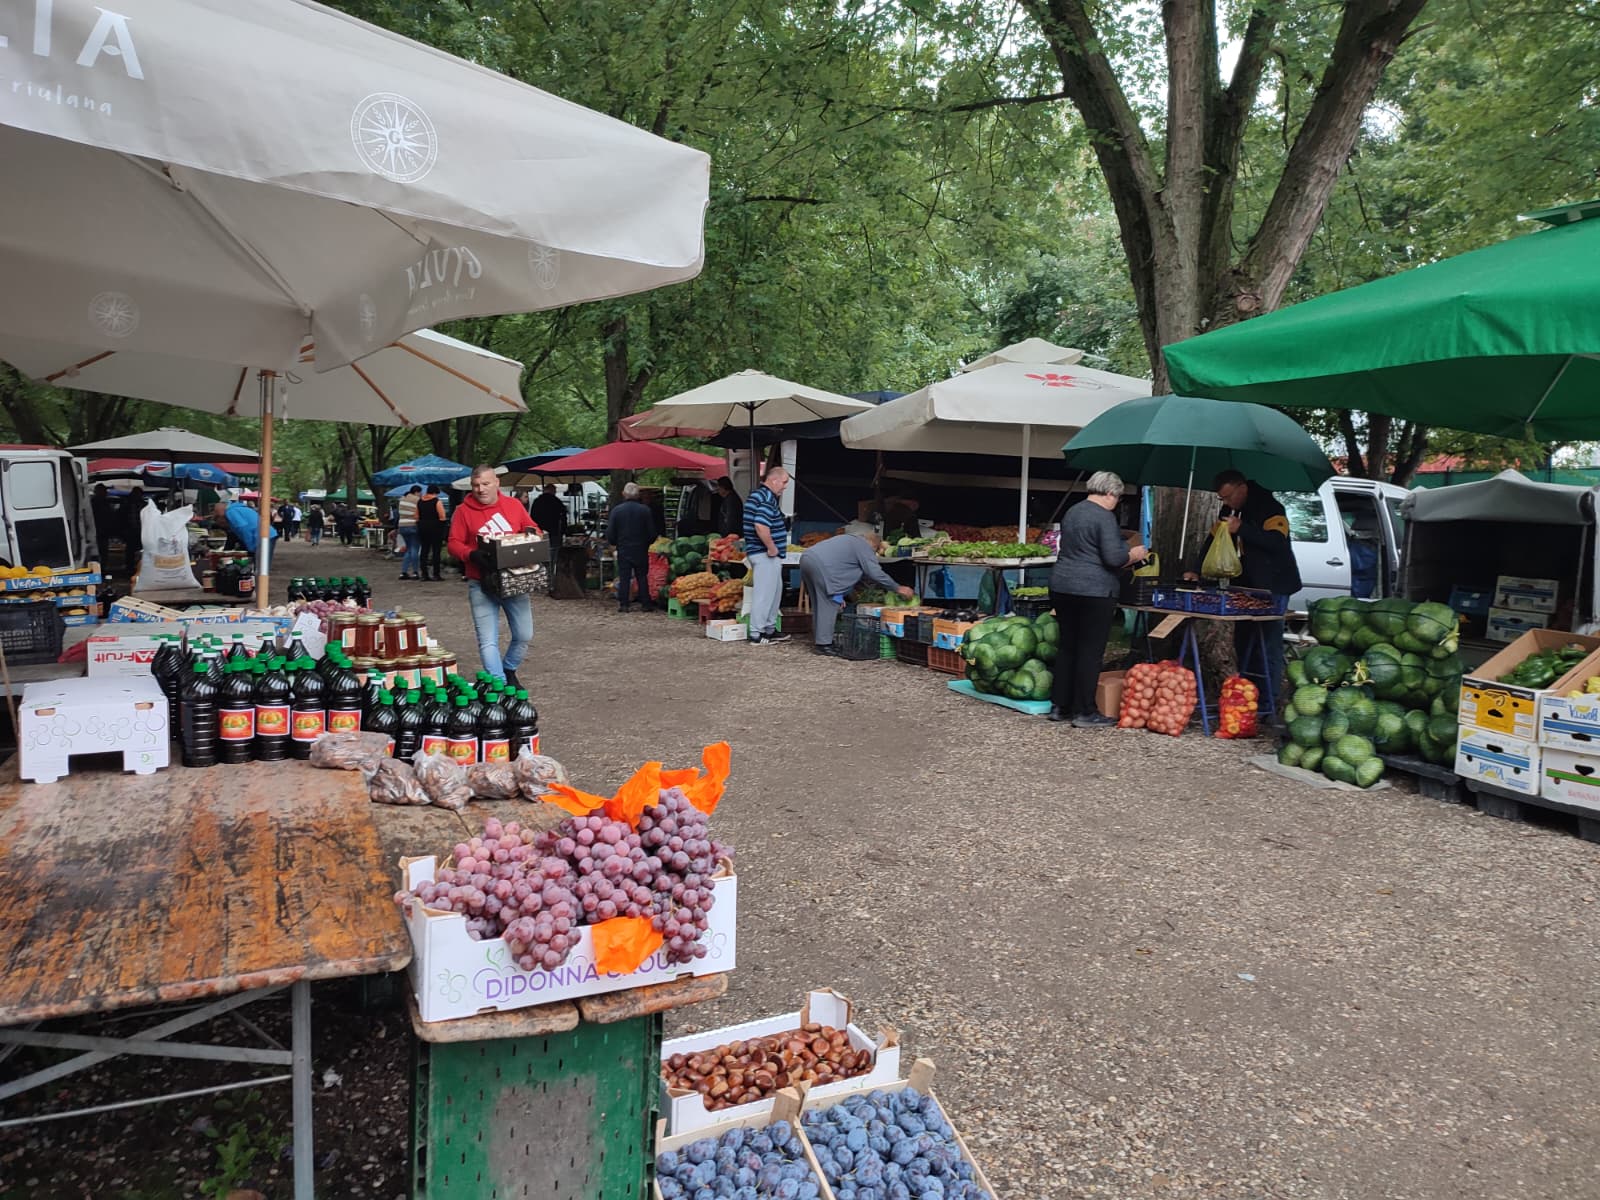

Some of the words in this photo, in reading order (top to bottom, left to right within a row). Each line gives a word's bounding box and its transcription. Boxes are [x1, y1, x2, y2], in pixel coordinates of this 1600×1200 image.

[0, 0, 145, 80] IA
[0, 74, 113, 117] riulana
[486, 964, 600, 1000] DIDONNA
